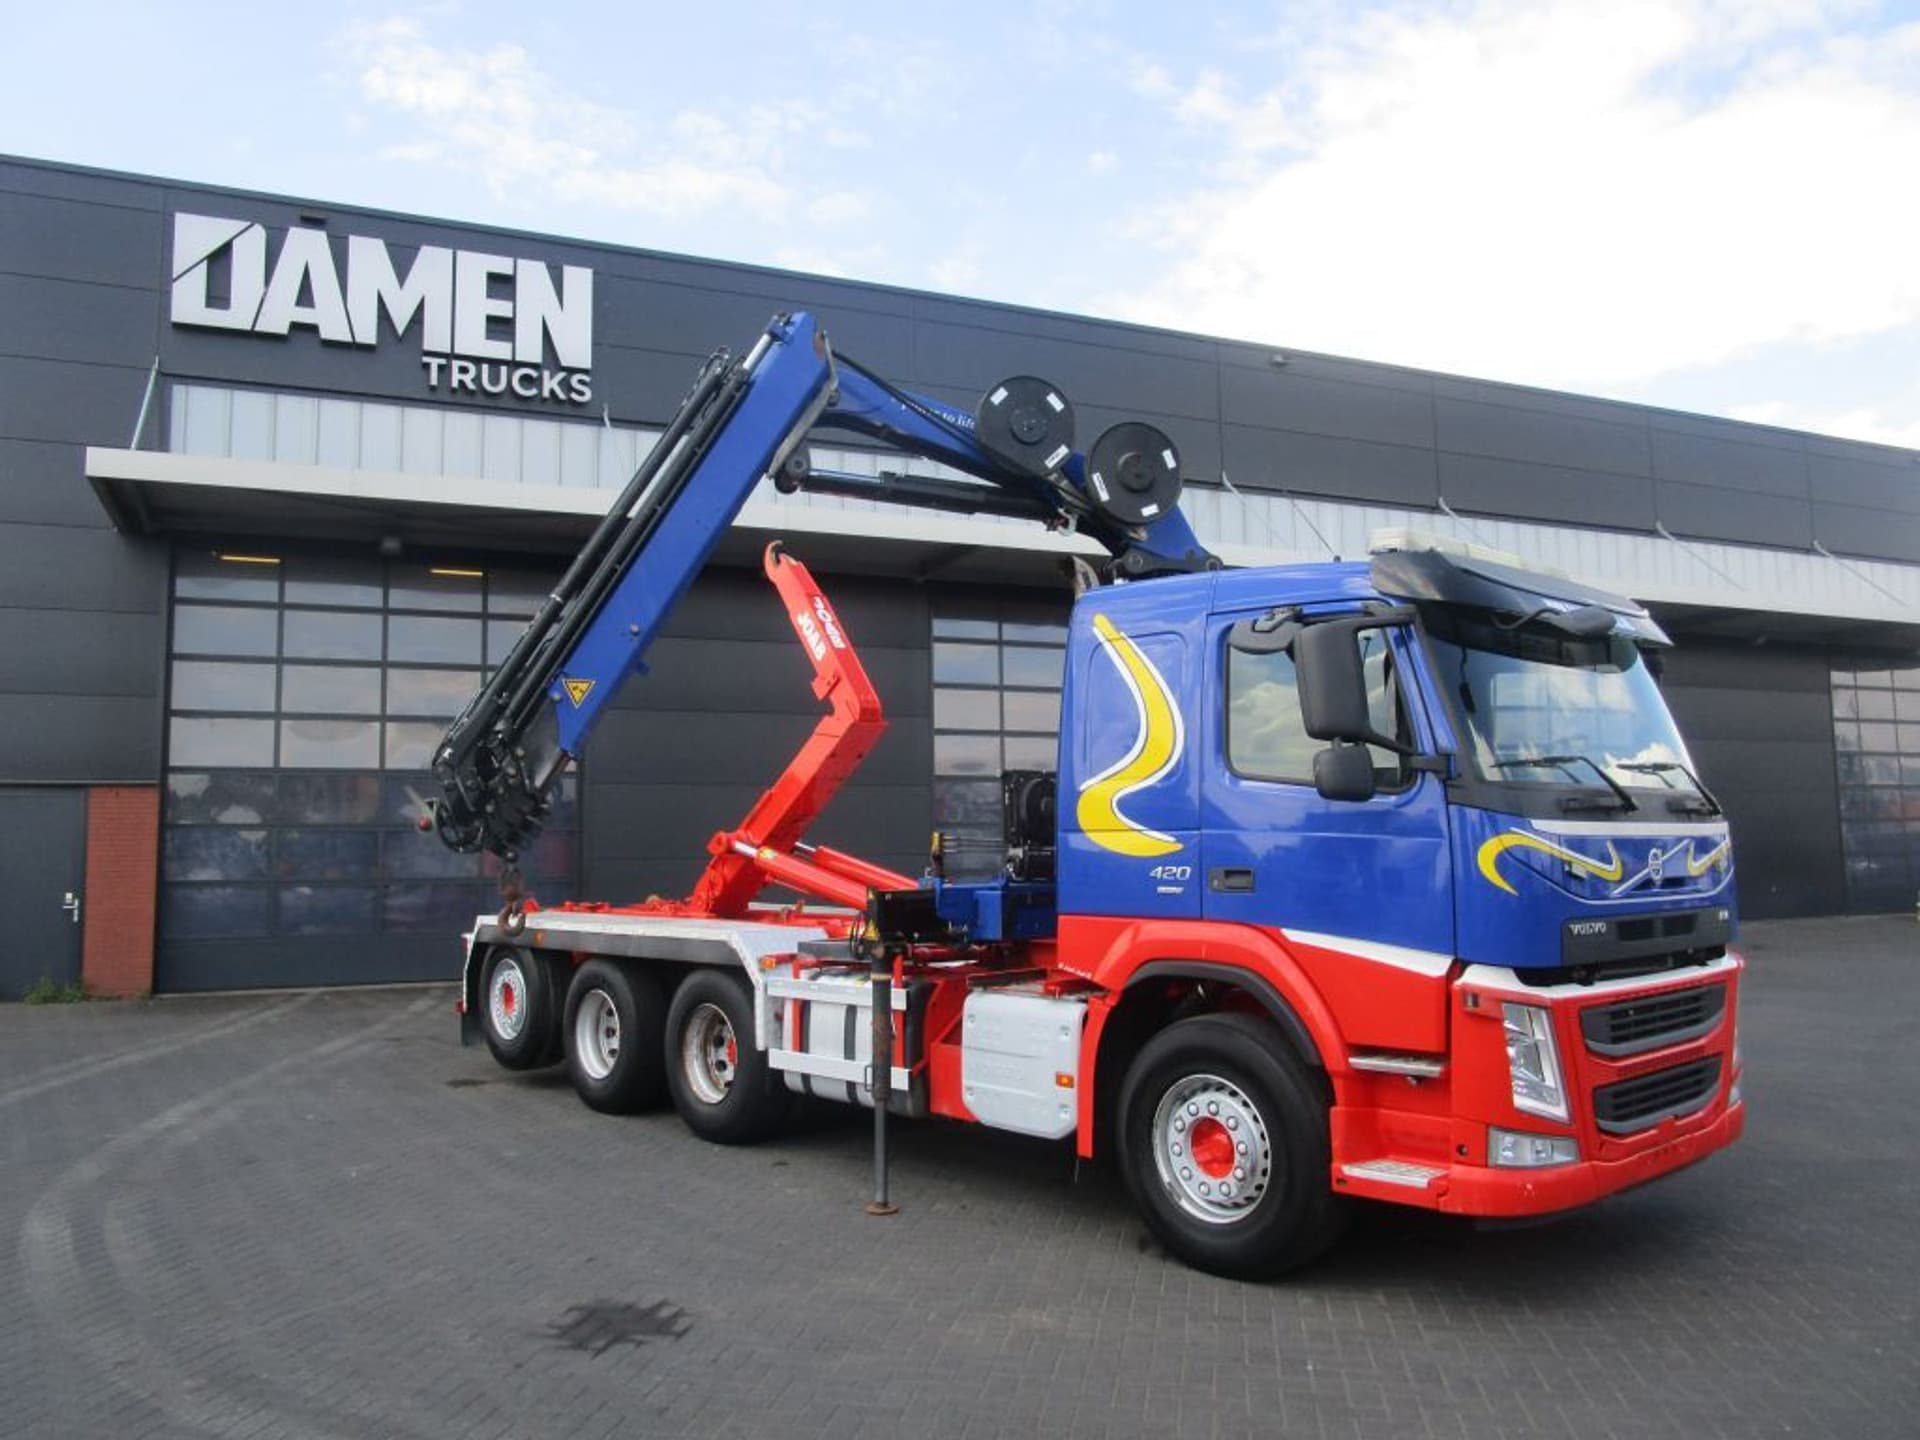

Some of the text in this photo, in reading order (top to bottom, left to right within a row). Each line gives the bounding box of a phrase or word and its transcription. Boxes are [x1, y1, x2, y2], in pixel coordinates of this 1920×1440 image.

[170, 211, 594, 370] DAMEN
[421, 355, 593, 403] TRUCKS
[1149, 865, 1192, 881] 420
[1568, 921, 1607, 936] VOLVO
